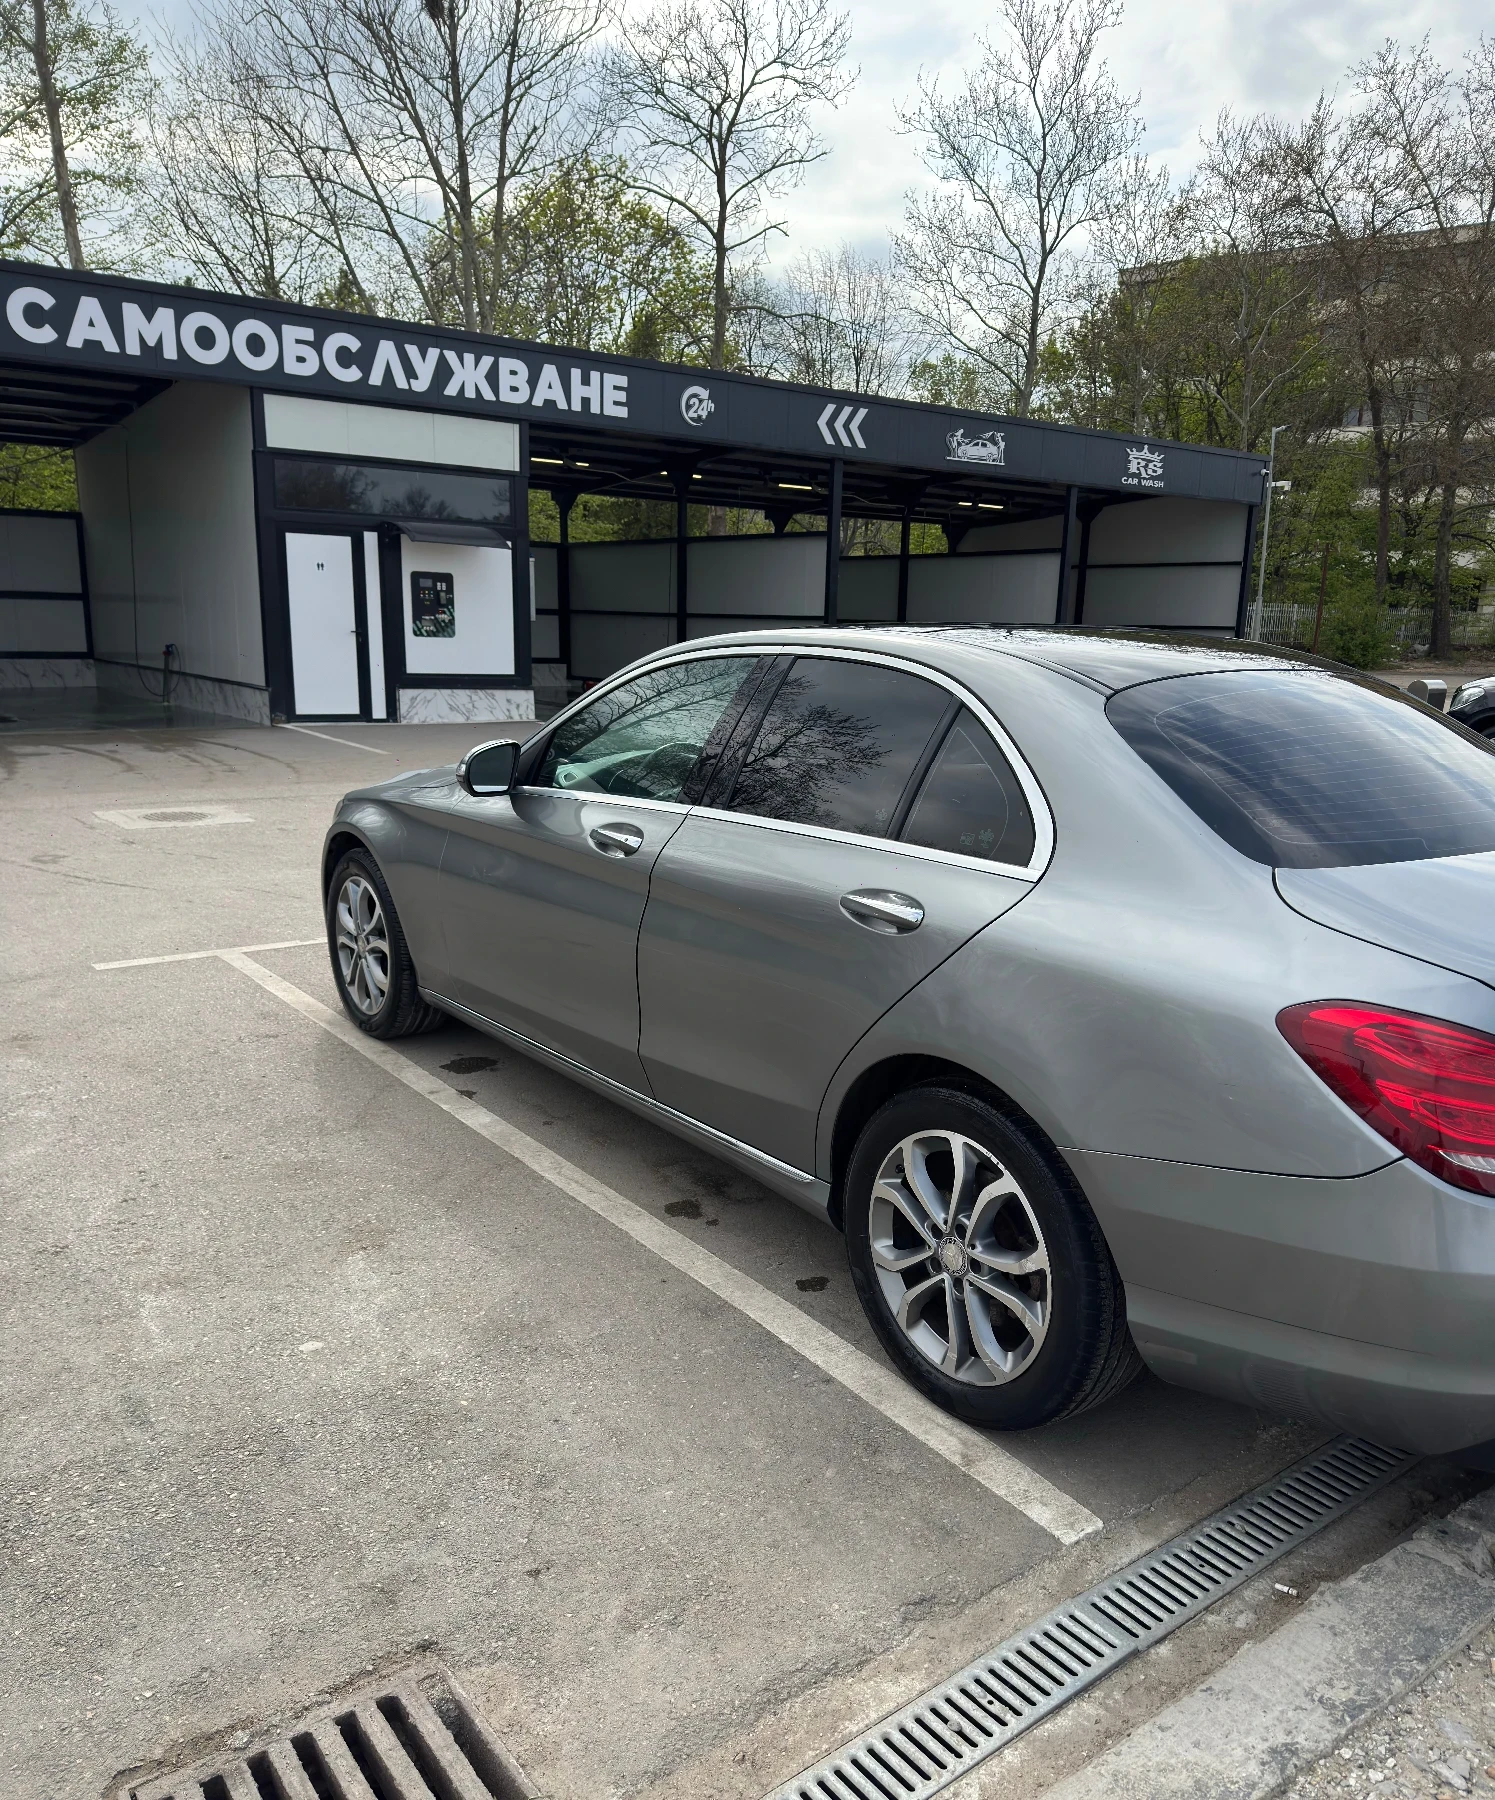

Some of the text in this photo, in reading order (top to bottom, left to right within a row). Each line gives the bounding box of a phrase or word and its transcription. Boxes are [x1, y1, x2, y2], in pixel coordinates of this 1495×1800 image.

[6, 286, 628, 418] САМООБСЛУЖВАНЕ
[687, 397, 715, 420] 24h
[1127, 458, 1164, 478] RS
[1121, 476, 1165, 488] CAR WASH
